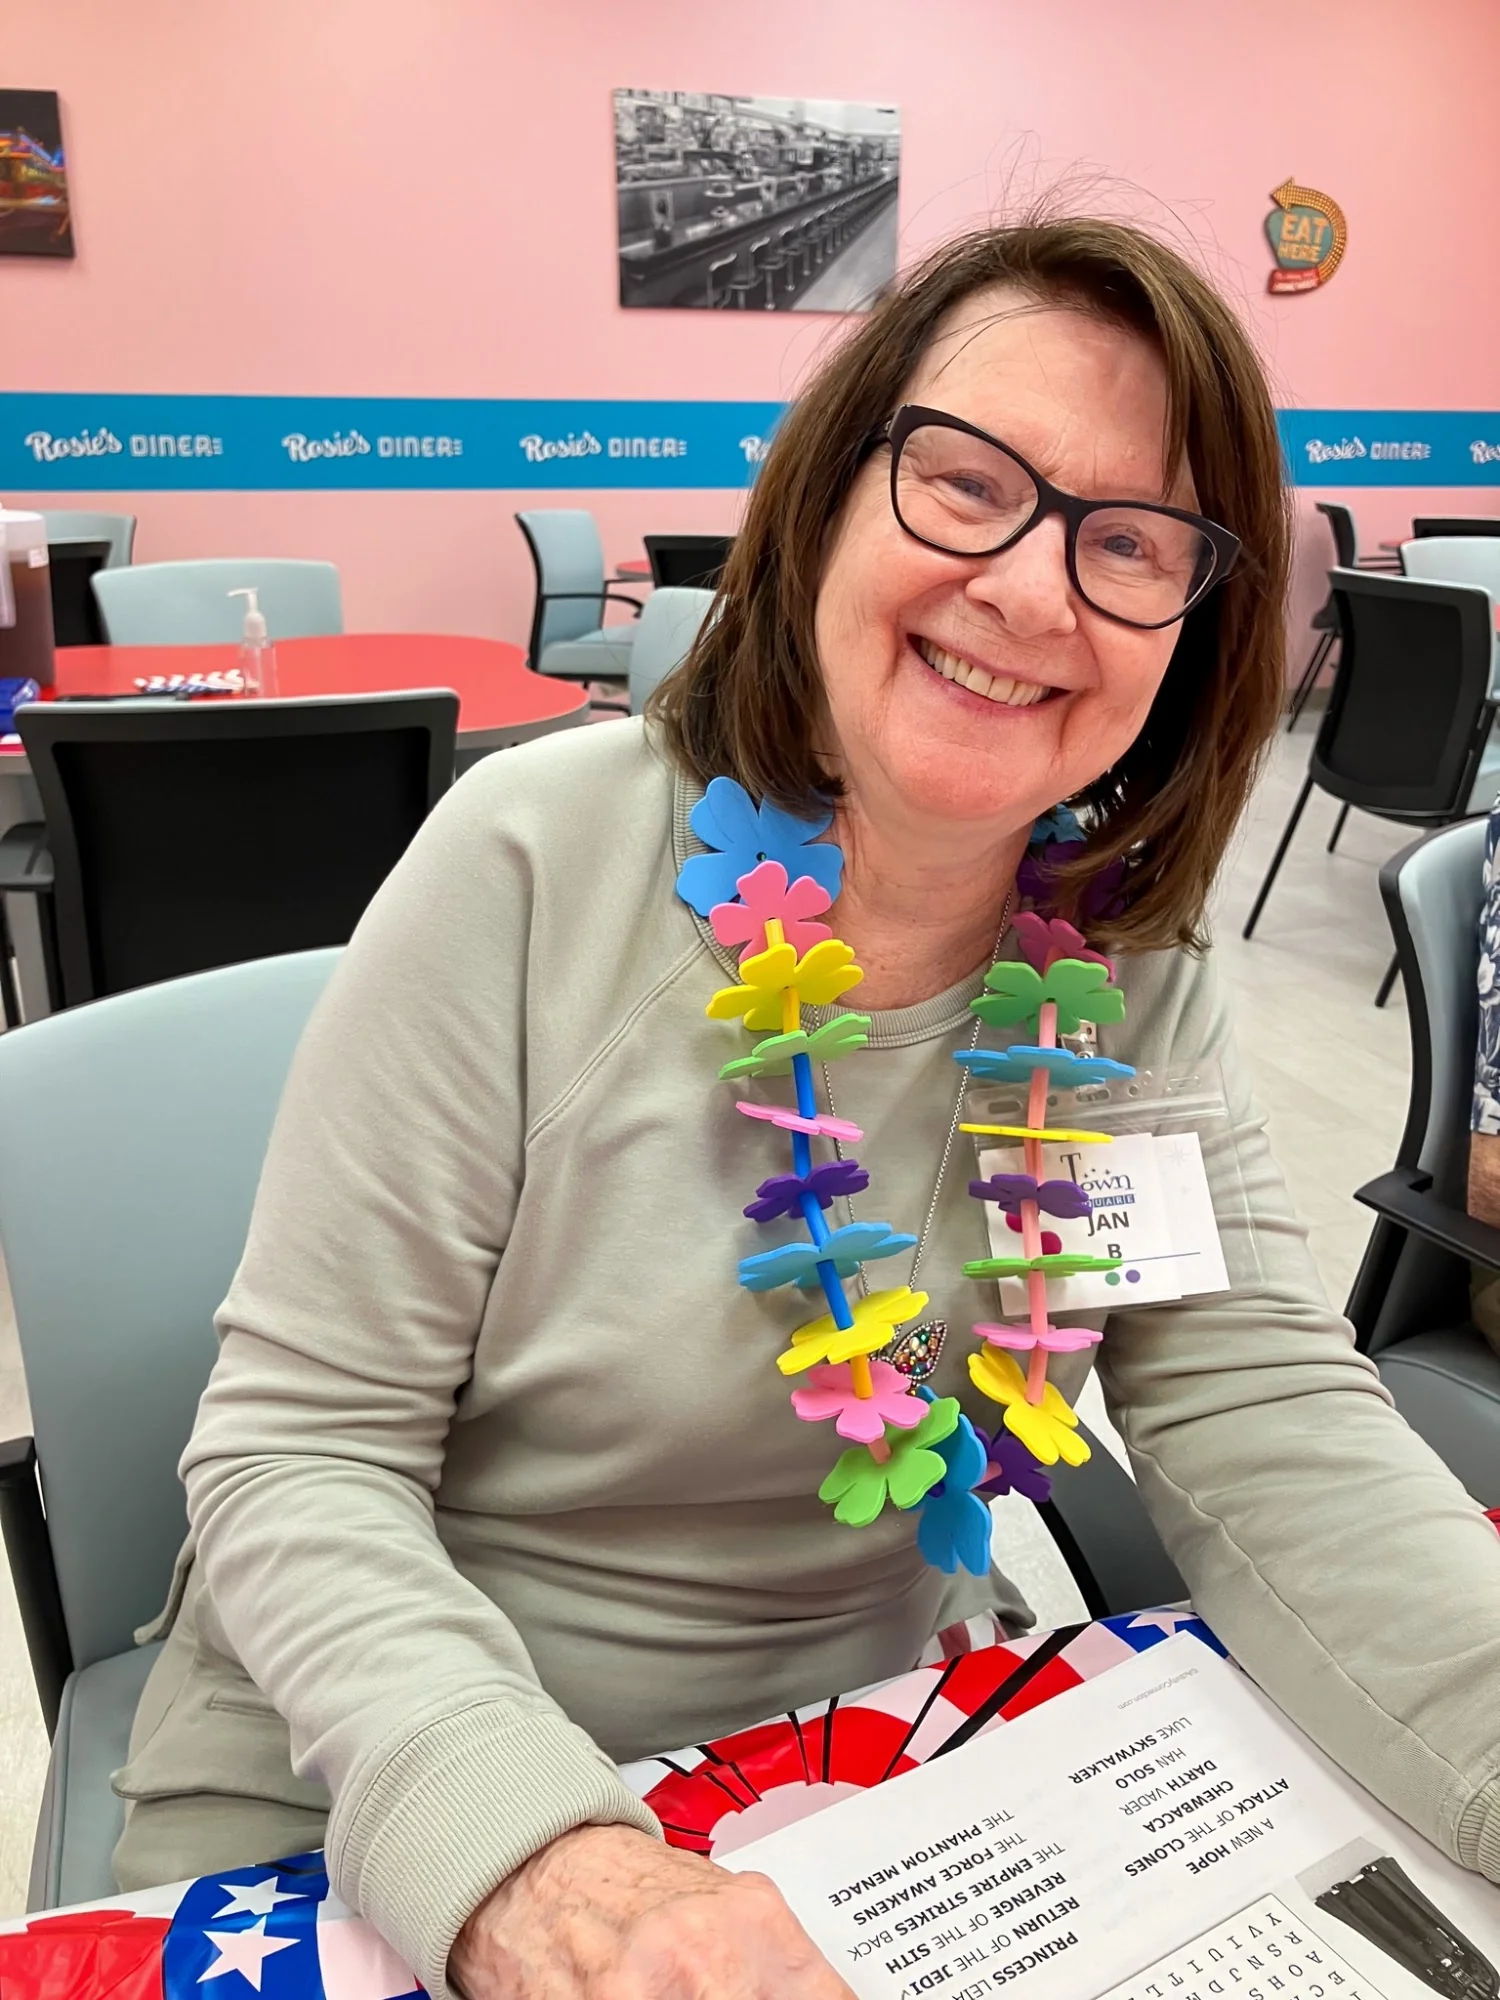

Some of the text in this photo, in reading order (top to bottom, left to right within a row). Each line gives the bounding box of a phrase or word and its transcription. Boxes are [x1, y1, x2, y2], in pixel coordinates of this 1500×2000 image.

[1282, 213, 1328, 243] EAT
[24, 427, 214, 462] Rosie's DINER
[281, 429, 453, 462] Rosie's DINER
[520, 430, 678, 462] Rosie's DINER
[1305, 436, 1367, 463] Rosie's
[1060, 1152, 1134, 1191] Town
[1084, 1194, 1135, 1208] UARE
[1087, 1211, 1130, 1237] JAN
[1107, 1243, 1122, 1259] B
[1068, 1717, 1192, 1785] LUKE SKYWALKER
[1115, 1747, 1186, 1789] HAN SOLO
[1118, 1760, 1218, 1816] DARTH VADER
[1142, 1780, 1234, 1833] CHEWBACCA
[1125, 1778, 1289, 1877] ATTACK OF THE CLONES
[1185, 1818, 1274, 1875] A NEW HOPE
[828, 1809, 1015, 1907] THE PHANTOM MENACE
[853, 1832, 1027, 1926] THE FORCE AWAKENS
[847, 1842, 1065, 1961] THE EMPIRE STRIKES BACK
[885, 1872, 1067, 1974] REVENGE OF THE SITH
[909, 1896, 1080, 1995] RETURN OF THE JEDI
[992, 1931, 1079, 1985] PRINCESS
